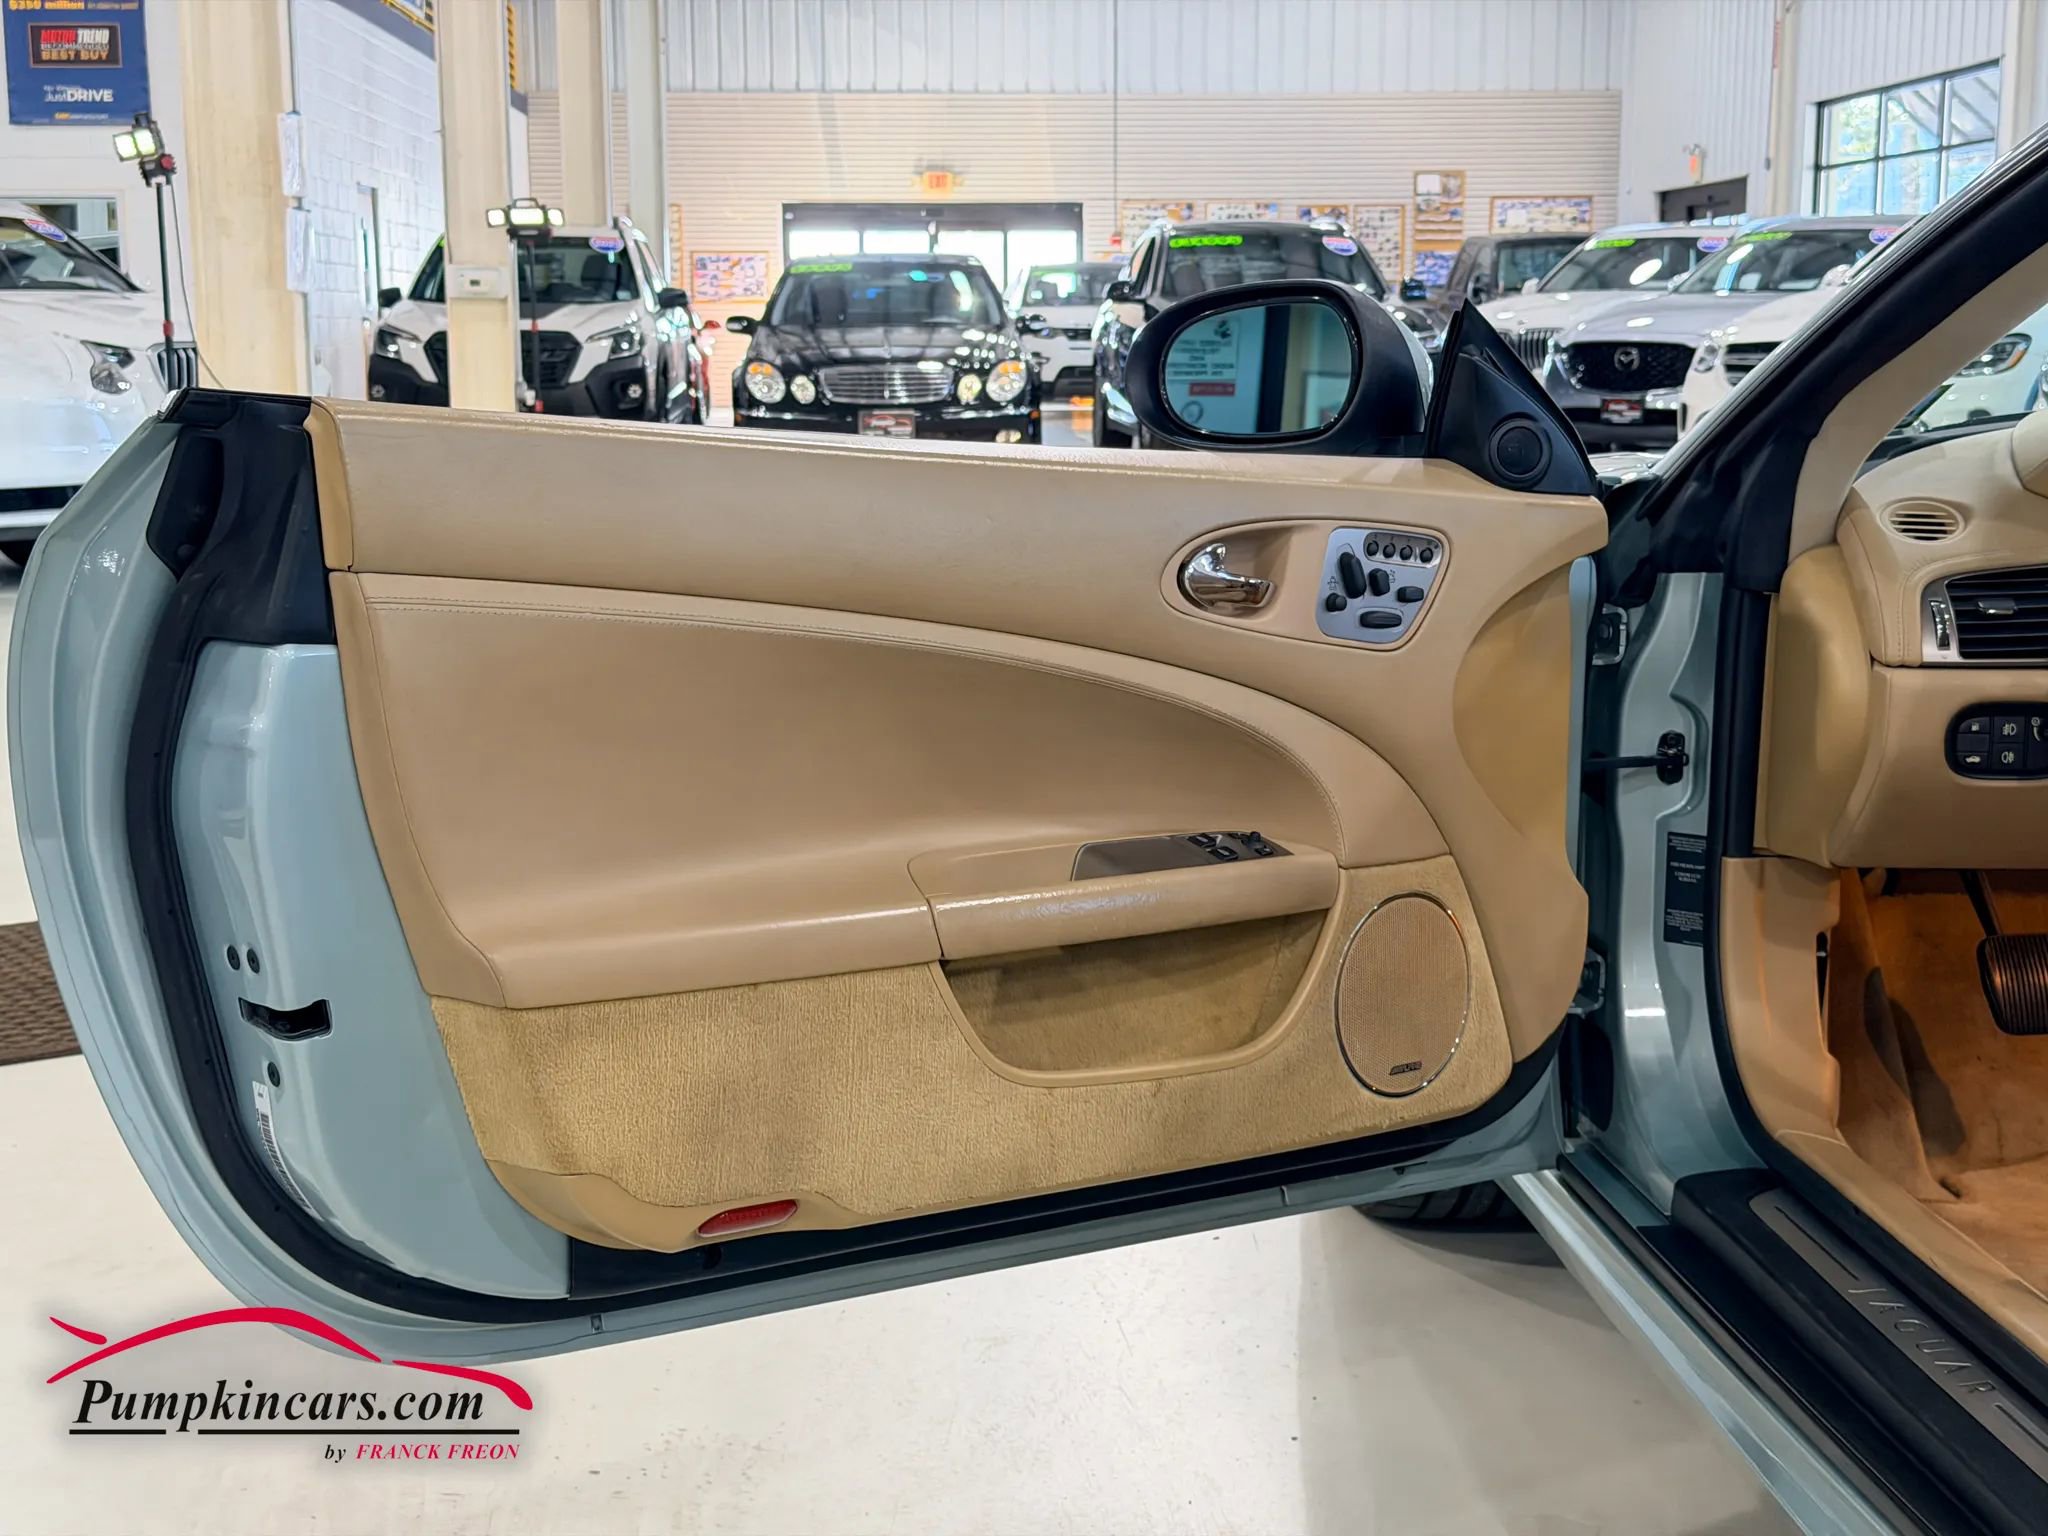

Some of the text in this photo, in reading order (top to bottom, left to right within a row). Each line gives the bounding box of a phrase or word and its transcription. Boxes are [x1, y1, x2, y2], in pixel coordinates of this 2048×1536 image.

[41, 28, 110, 43] MOTOR TREND
[41, 50, 109, 60] BEST BUY
[1848, 1288, 1996, 1393] JAGUAR
